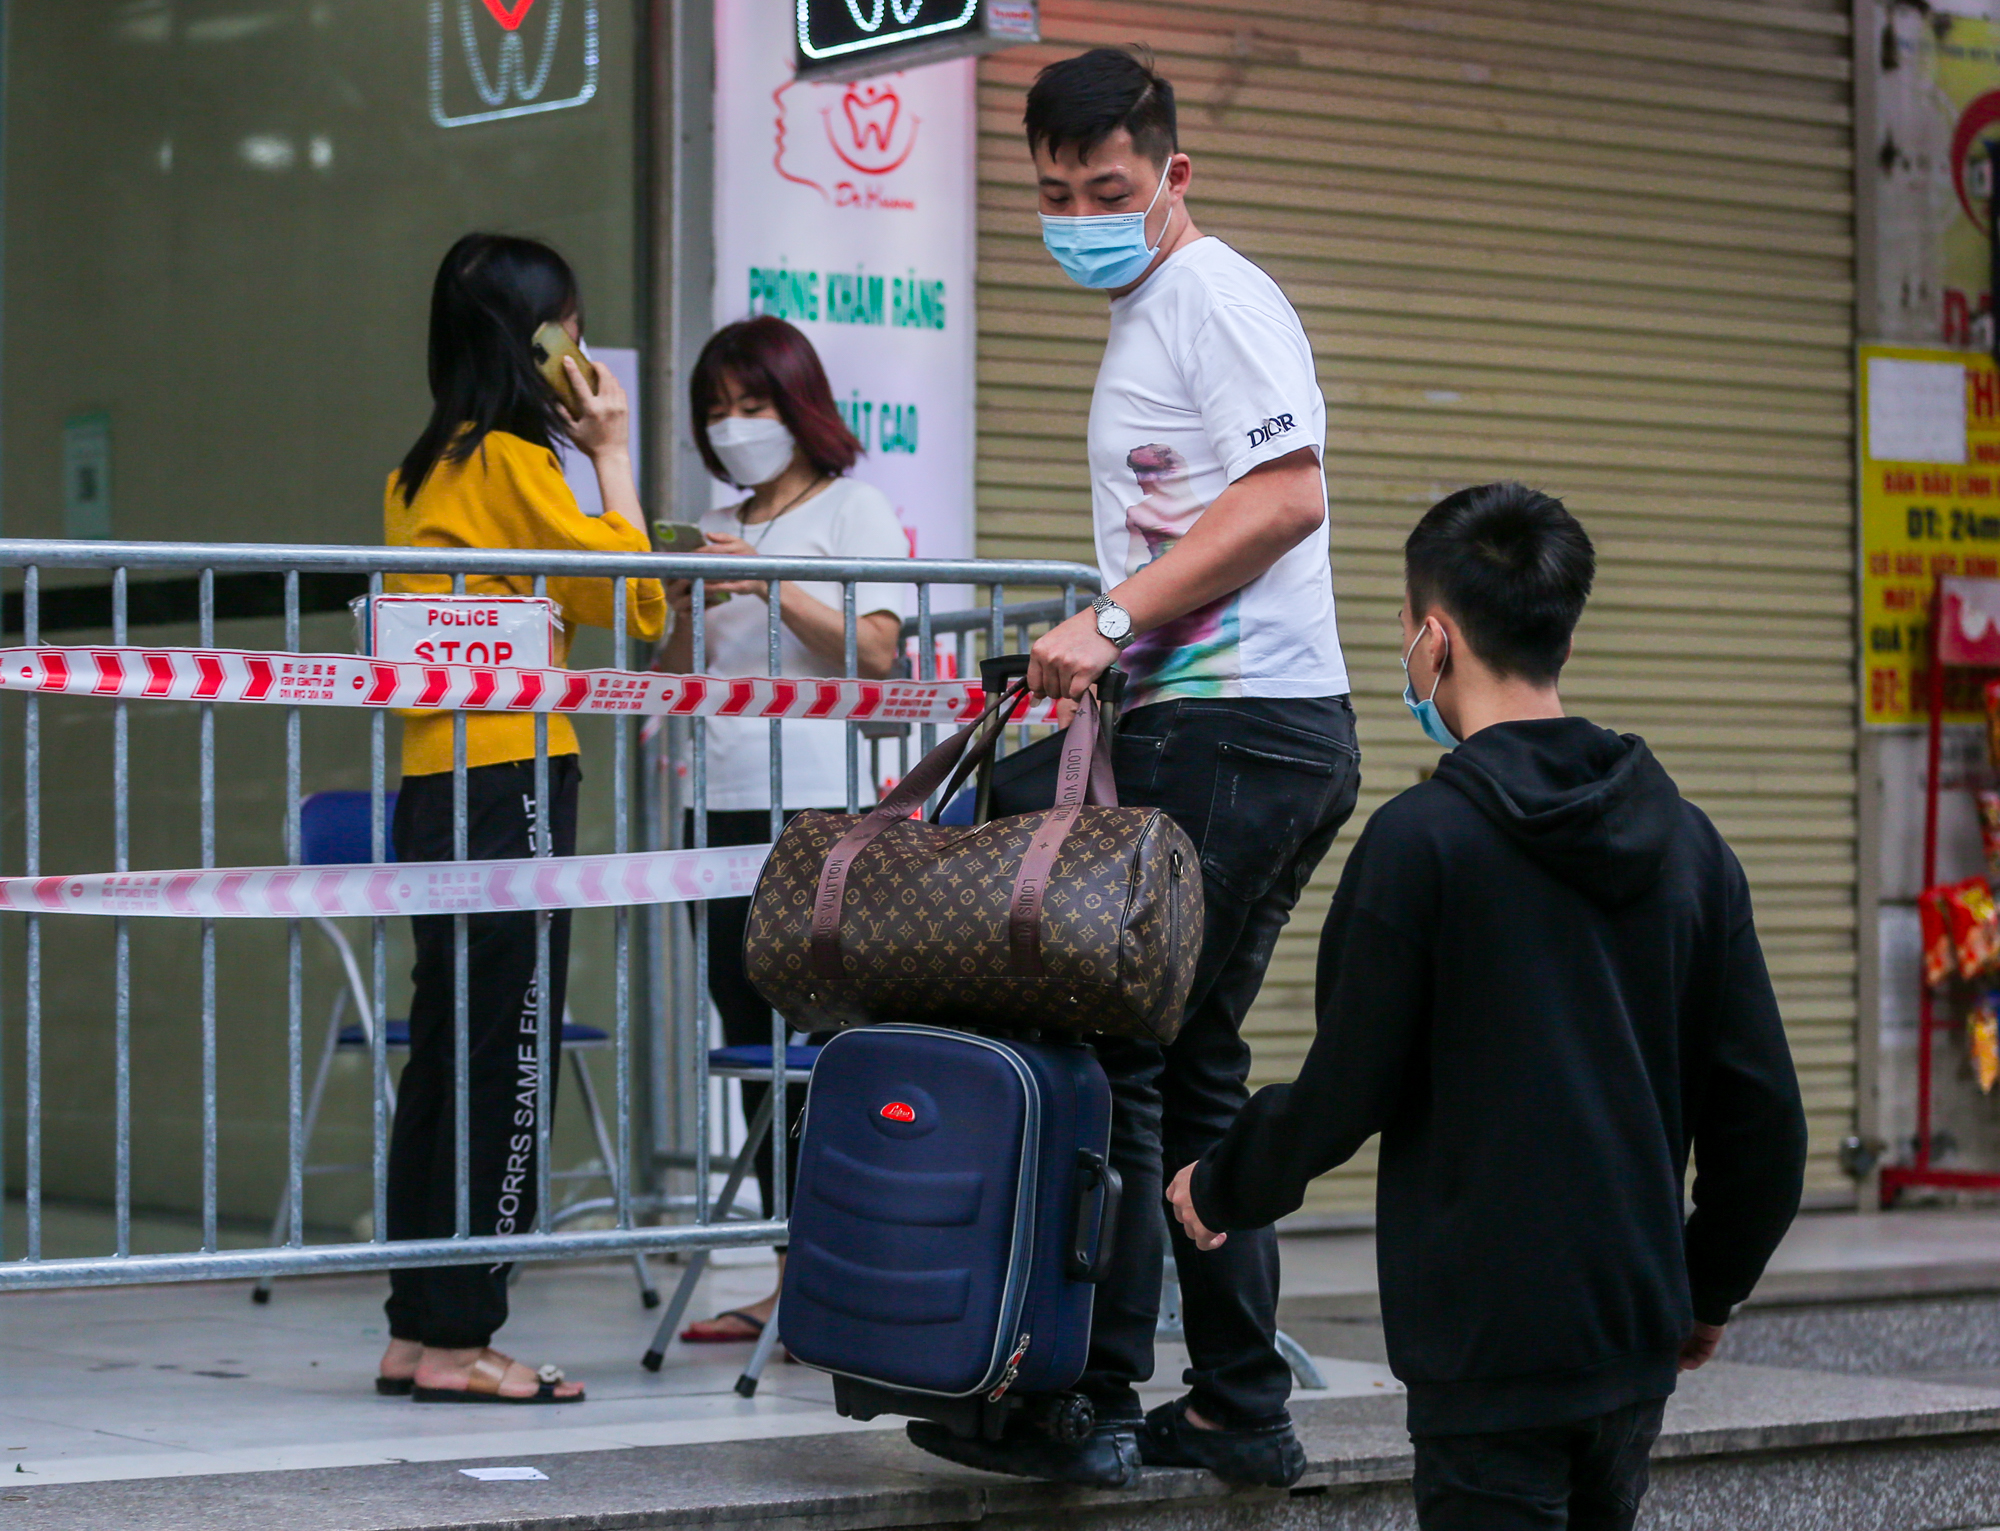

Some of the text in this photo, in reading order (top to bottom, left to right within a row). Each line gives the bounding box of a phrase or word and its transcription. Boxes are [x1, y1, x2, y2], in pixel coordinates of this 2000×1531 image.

[880, 403, 918, 453] CAO
[1247, 413, 1297, 449] DIOR
[428, 609, 498, 626] POLICE
[414, 641, 513, 666] STOP
[1053, 748, 1082, 822] LOUIS VUITTON
[821, 859, 845, 912] VUITTON
[1018, 878, 1037, 916] LOUIS
[514, 1044, 538, 1128] SAME
